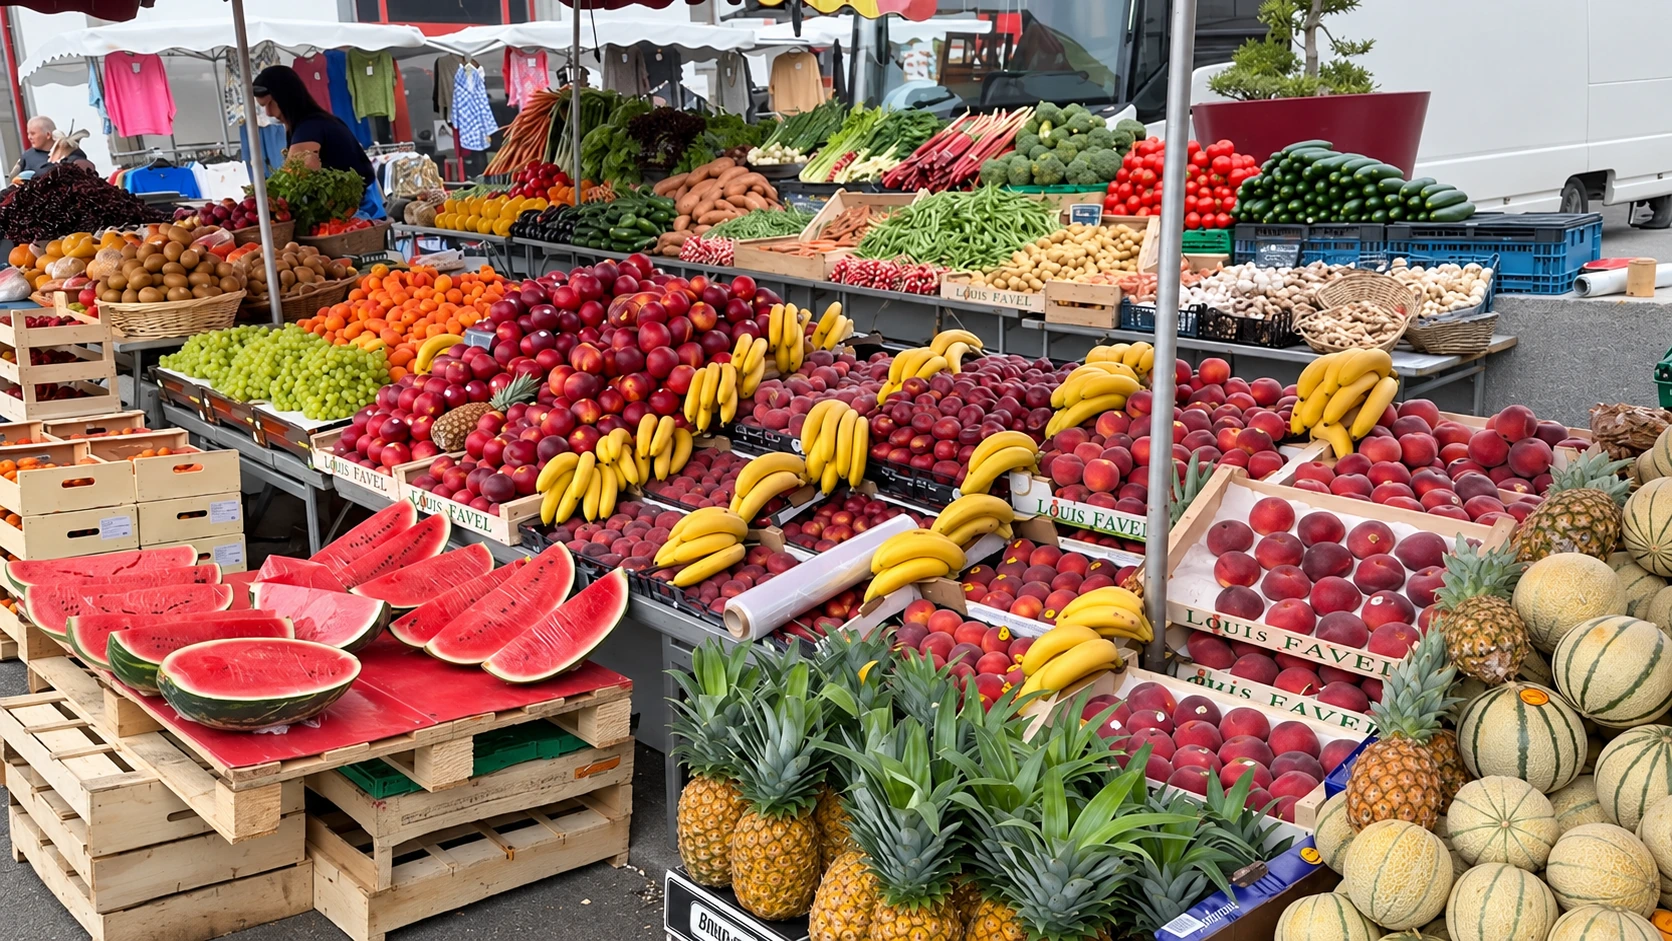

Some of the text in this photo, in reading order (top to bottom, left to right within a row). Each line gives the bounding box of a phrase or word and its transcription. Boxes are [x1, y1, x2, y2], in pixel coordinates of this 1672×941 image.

[956, 287, 1032, 306] LOUIS FAVEL
[324, 455, 387, 491] LOUIS FAVEL
[411, 490, 492, 533] LOUIS FAVEL
[1037, 499, 1085, 524] LOUIS
[1186, 609, 1267, 642] LOUIS
